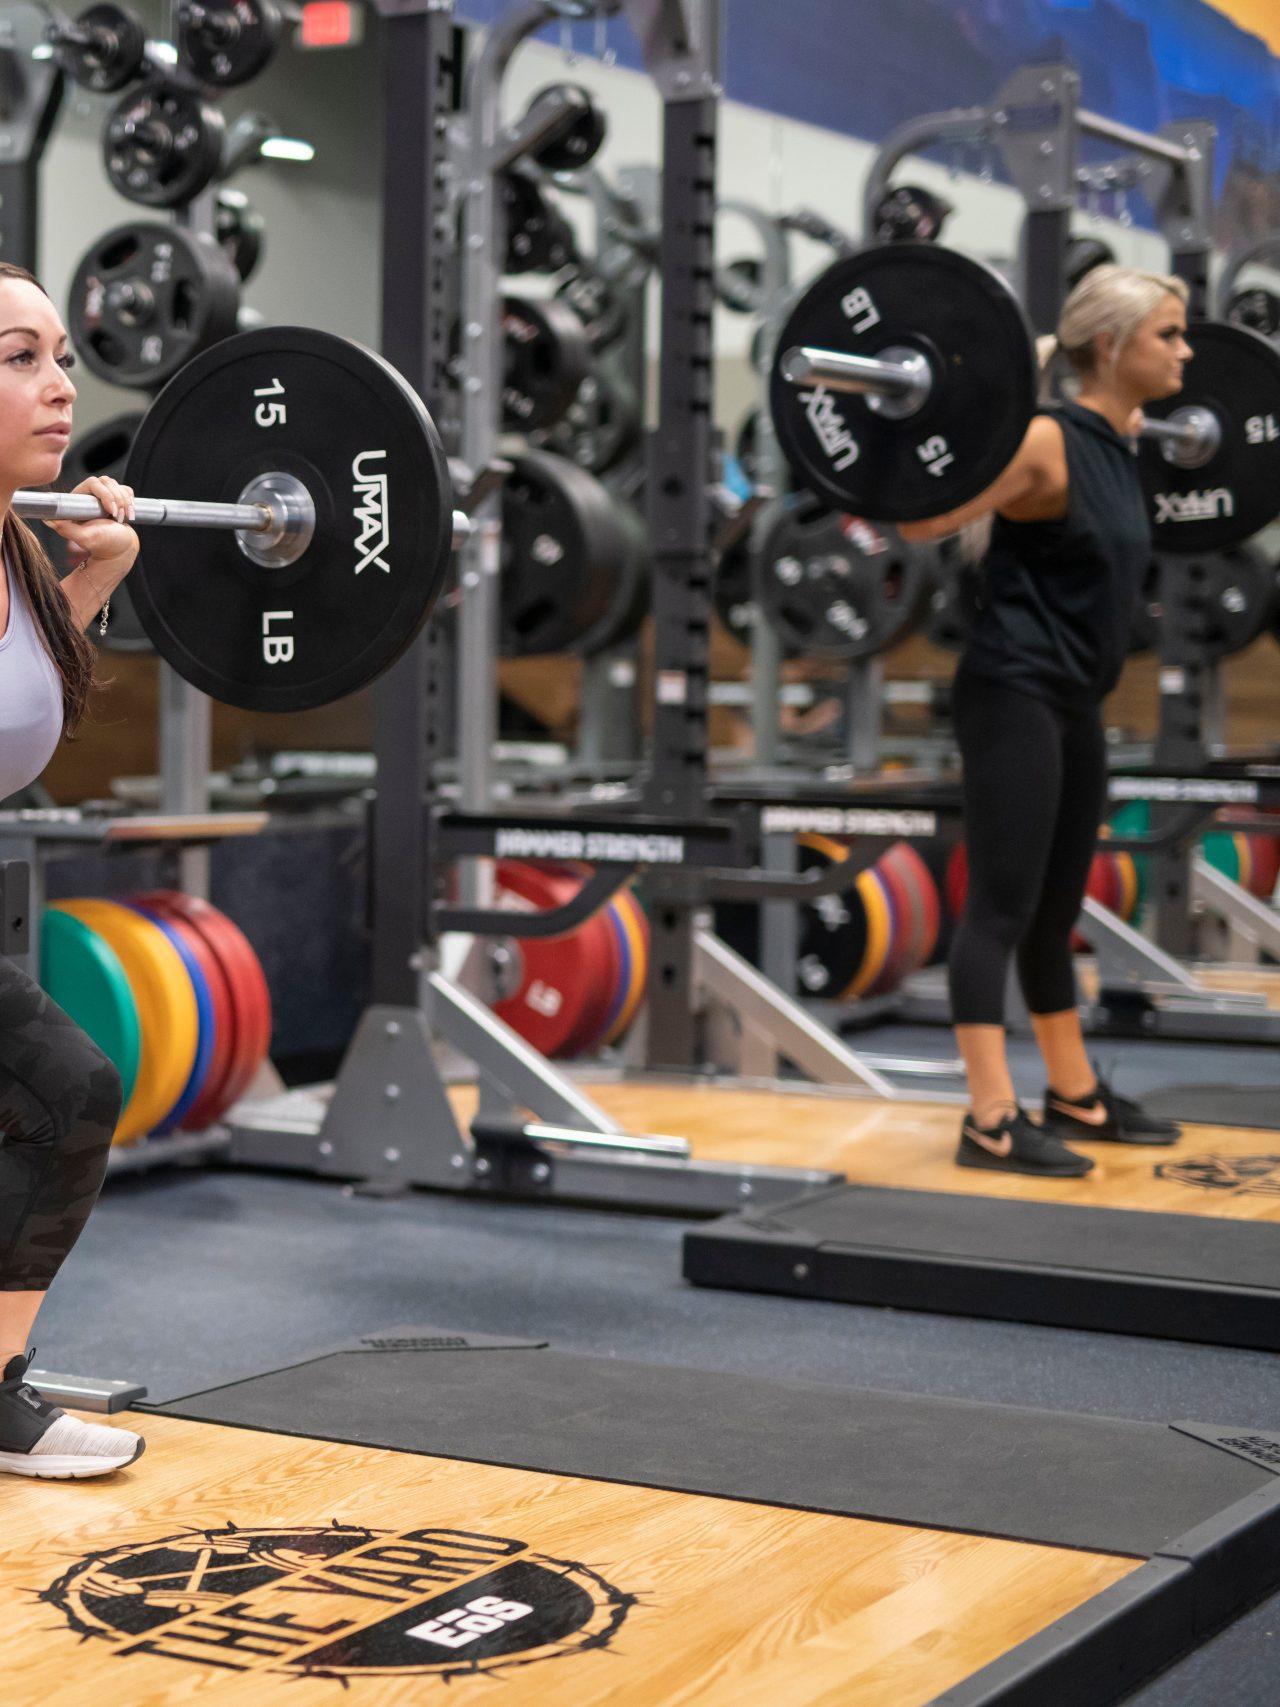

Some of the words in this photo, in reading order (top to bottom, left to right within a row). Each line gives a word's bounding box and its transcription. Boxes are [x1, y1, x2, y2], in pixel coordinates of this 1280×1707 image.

[841, 286, 881, 336] LB
[253, 377, 287, 428] 15
[797, 383, 859, 472] UMAX
[1244, 413, 1280, 445] 15
[916, 435, 955, 477] 15
[351, 450, 390, 575] UMAX
[1154, 488, 1233, 523] UMAX
[262, 610, 295, 665] LB
[113, 1601, 358, 1672] THE
[275, 1527, 530, 1604] YARD
